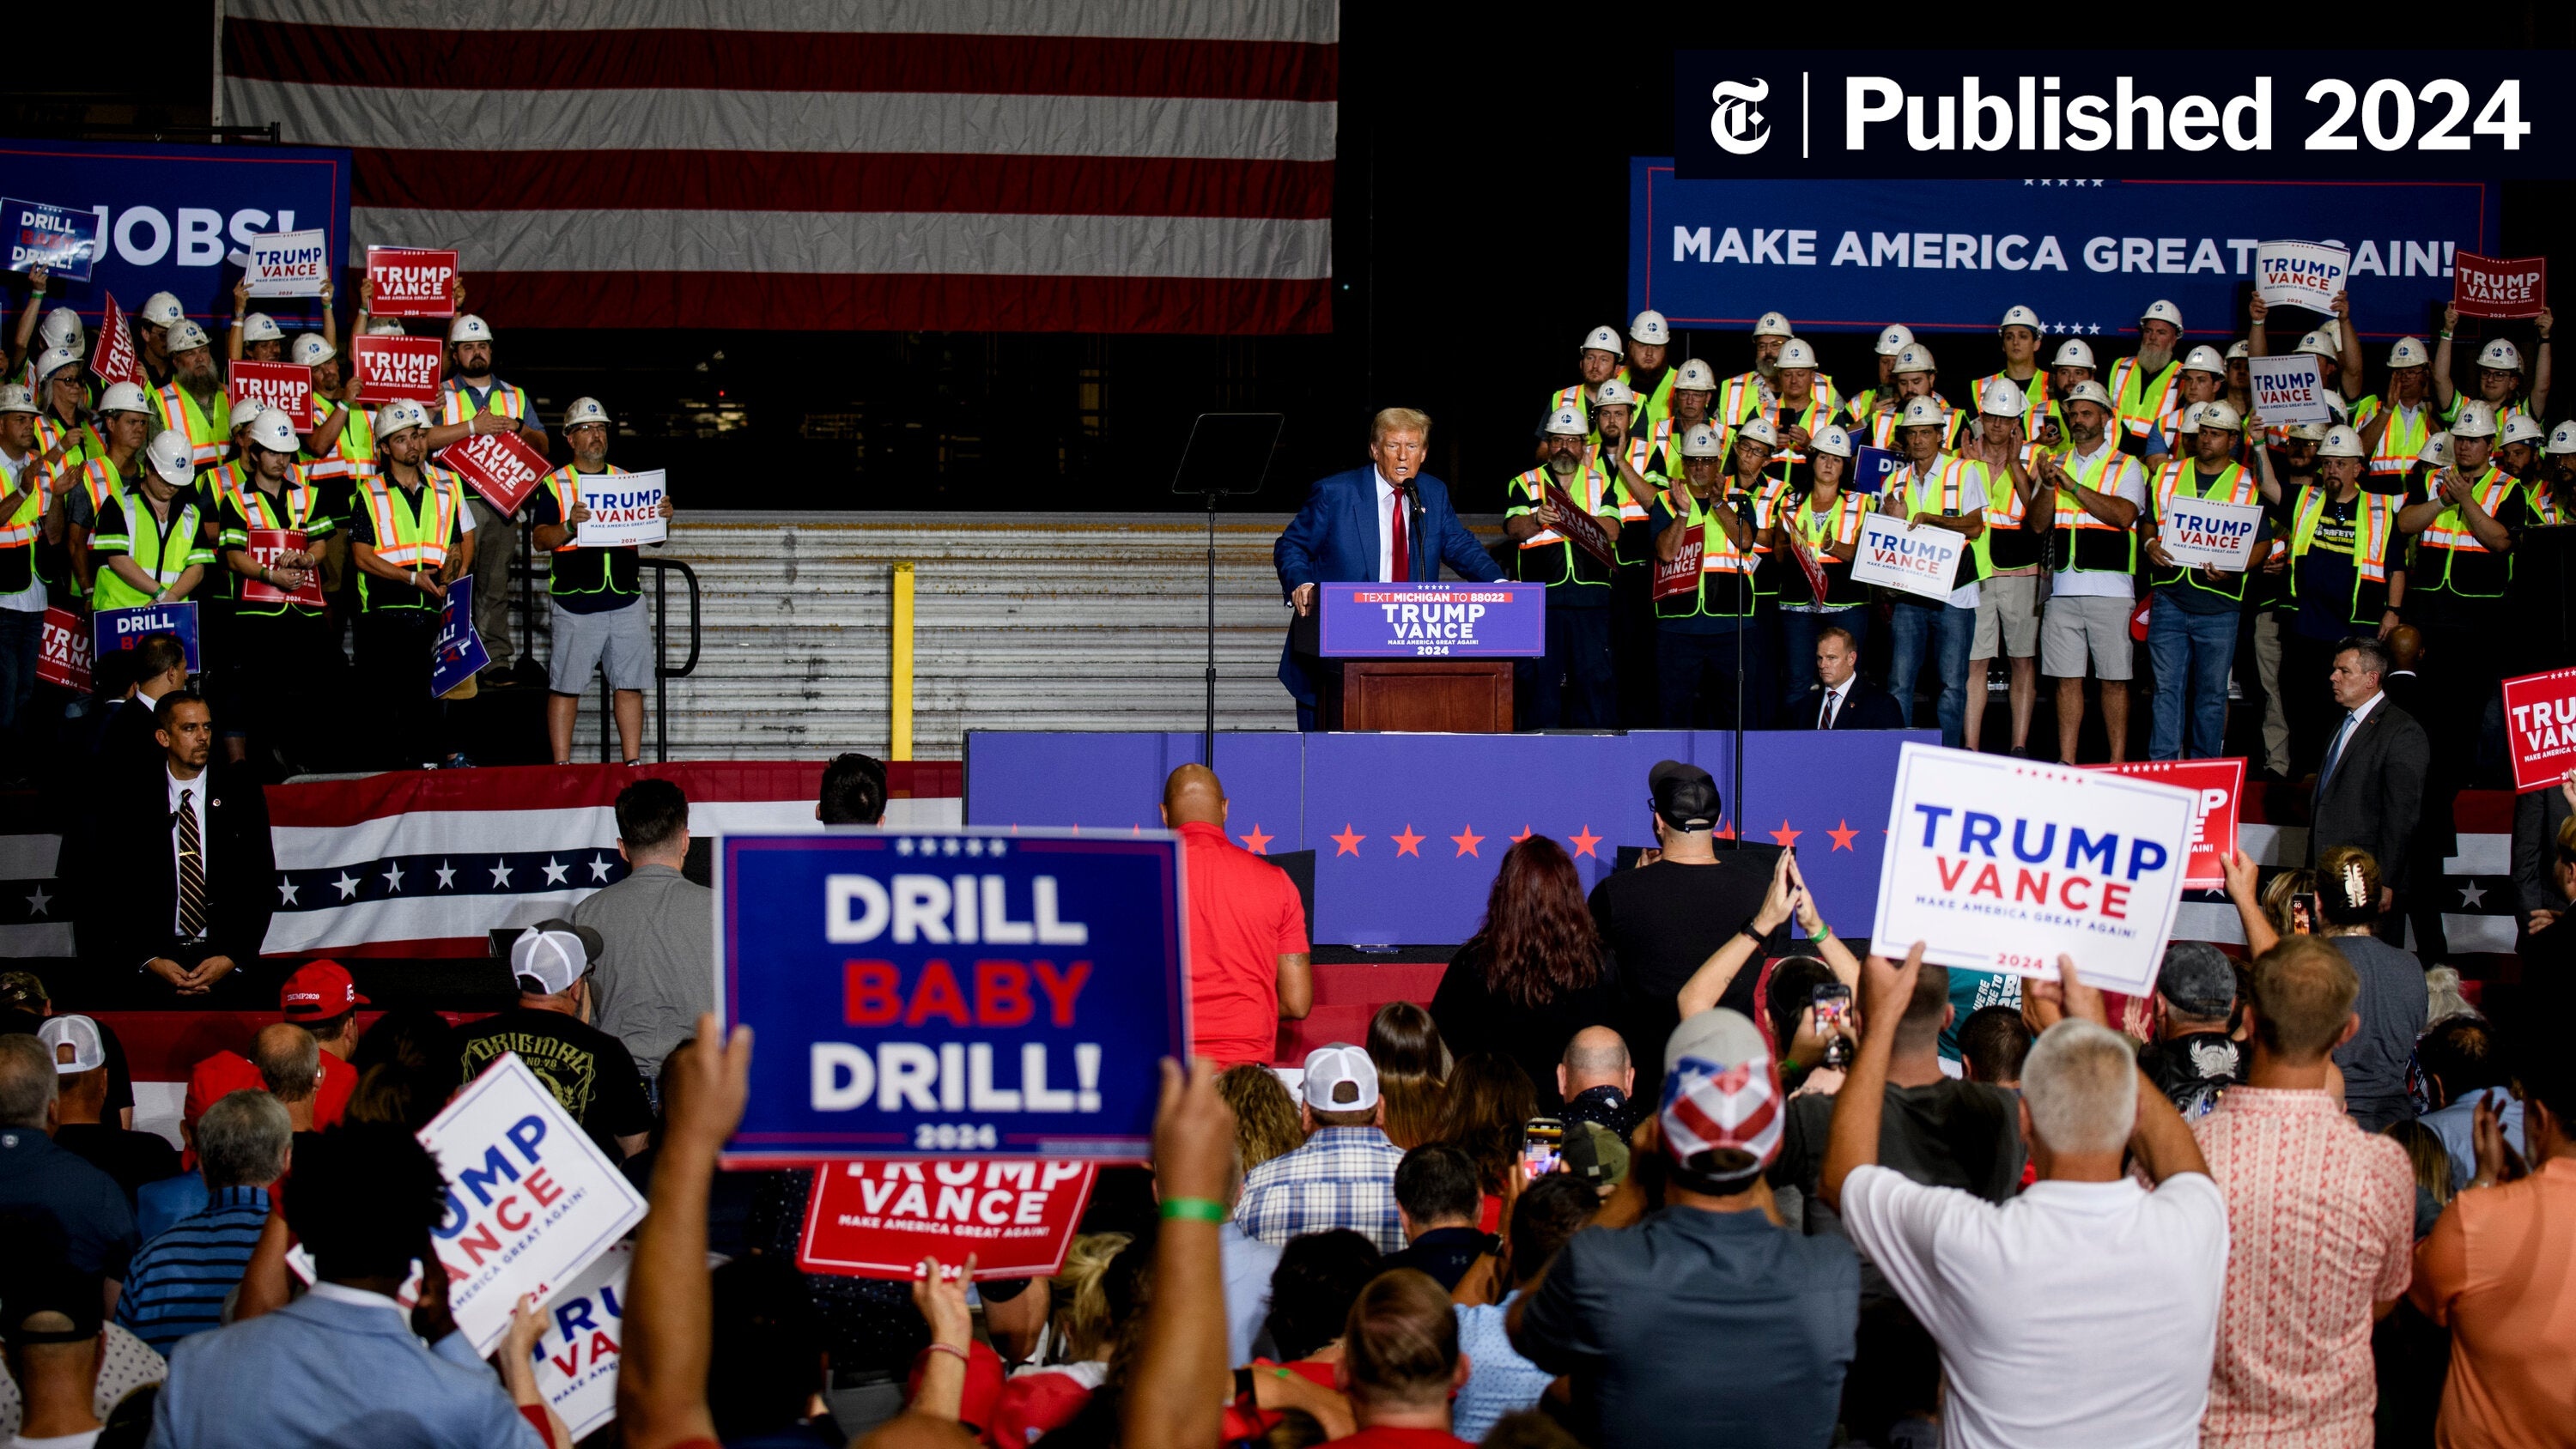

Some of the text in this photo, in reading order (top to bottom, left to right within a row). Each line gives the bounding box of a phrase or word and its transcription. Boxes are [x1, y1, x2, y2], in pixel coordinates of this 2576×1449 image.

[21, 211, 76, 234] DRILL
[12, 246, 73, 270] DRILL!
[256, 247, 322, 265] TRUMP
[1673, 226, 2455, 276] MAKE AMERICA GREAT AIN!
[262, 264, 317, 277] VANCE
[373, 267, 452, 282] TRUMP
[2263, 258, 2341, 279] TRUMP
[2460, 267, 2540, 288] TRUMP
[382, 282, 442, 295] VANCE
[2269, 273, 2330, 291] VANCE
[2467, 284, 2530, 300] VANCE
[105, 306, 126, 378] TRUMP
[361, 352, 438, 370] TRUMP
[370, 367, 429, 384] VANCE
[2254, 373, 2315, 391] TRUMP
[235, 378, 308, 397] TRUMP
[2261, 389, 2312, 403] VANCE
[244, 394, 301, 410] ANCE
[467, 440, 520, 490] VANCE
[470, 434, 537, 482] RUMP
[468, 476, 483, 489] 2024
[586, 488, 661, 509] TRUMP
[596, 506, 655, 523] VANCE
[1547, 495, 1608, 547] TRUMP
[2174, 512, 2252, 537] TRUMP
[2180, 530, 2240, 549] VANCE
[2324, 529, 2354, 537] SAFETY
[1674, 542, 1702, 562] UMP
[1868, 531, 1953, 562] TRUMP
[1662, 558, 1697, 578] VANCE
[1874, 549, 1940, 574] VANCE
[1882, 564, 1905, 573] AMERICA
[1363, 593, 1504, 602] TEXT MICHIGAN TO 88022
[117, 613, 174, 634] DRILL
[1382, 603, 1485, 623] TRUMP
[41, 622, 88, 652] TRU
[1393, 623, 1473, 639] VANCE
[1417, 646, 1449, 655] 2024
[60, 678, 78, 688] 2024
[2512, 696, 2576, 732] TRU
[2526, 723, 2576, 751] VAN
[2524, 753, 2541, 762] MAKE
[2543, 746, 2571, 759] AMERICA
[1915, 803, 2168, 881] TRUMP
[2191, 843, 2214, 853] AIN!
[1936, 856, 2131, 920] VANCE
[824, 872, 1088, 945] DRILL
[1916, 894, 2137, 939] MAKE AMERICA GREAT AGAIN!
[1996, 953, 2044, 971] 2024
[1991, 973, 2003, 989] TO
[841, 959, 1094, 1028] BABY
[471, 1032, 589, 1075] ORIGINAL
[809, 1040, 1103, 1113] DRILL!
[914, 1125, 999, 1151] 2024
[430, 1114, 547, 1239] UMP
[860, 1178, 1049, 1225] VANCE
[441, 1166, 564, 1286] ANCE
[501, 1226, 542, 1264] GREAT
[545, 1185, 589, 1229] AGAIN!
[838, 1214, 1050, 1239] MAKE AMERICA GREAT AGAIN!
[914, 1262, 963, 1279] 224
[552, 1379, 586, 1405] MAKE
